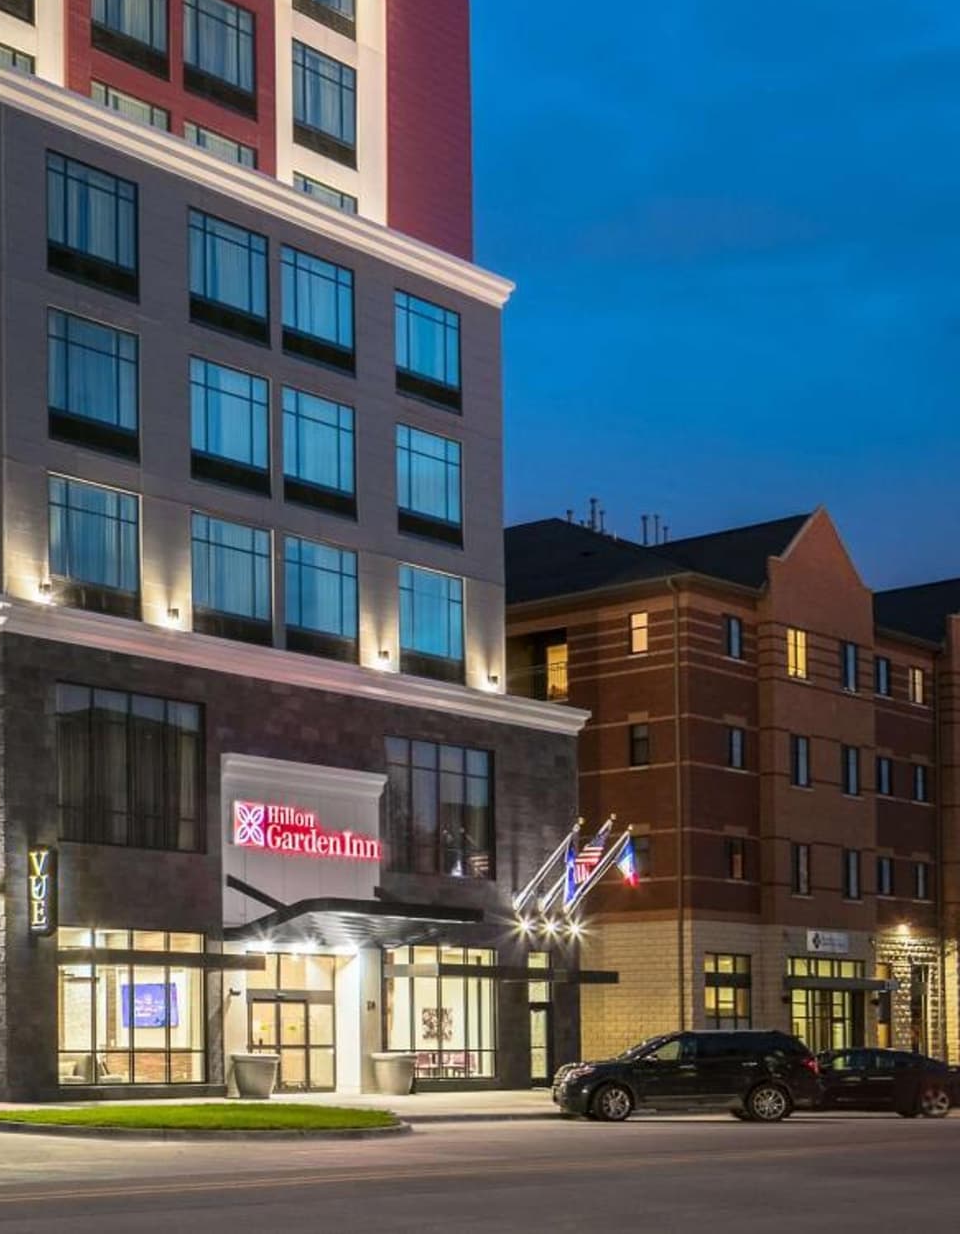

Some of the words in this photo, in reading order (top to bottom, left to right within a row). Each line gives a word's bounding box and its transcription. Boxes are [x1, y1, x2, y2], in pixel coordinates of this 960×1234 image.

[267, 805, 315, 828] Hilton
[266, 825, 341, 855] Garden
[344, 831, 380, 859] Inn
[29, 851, 49, 925] VUE
